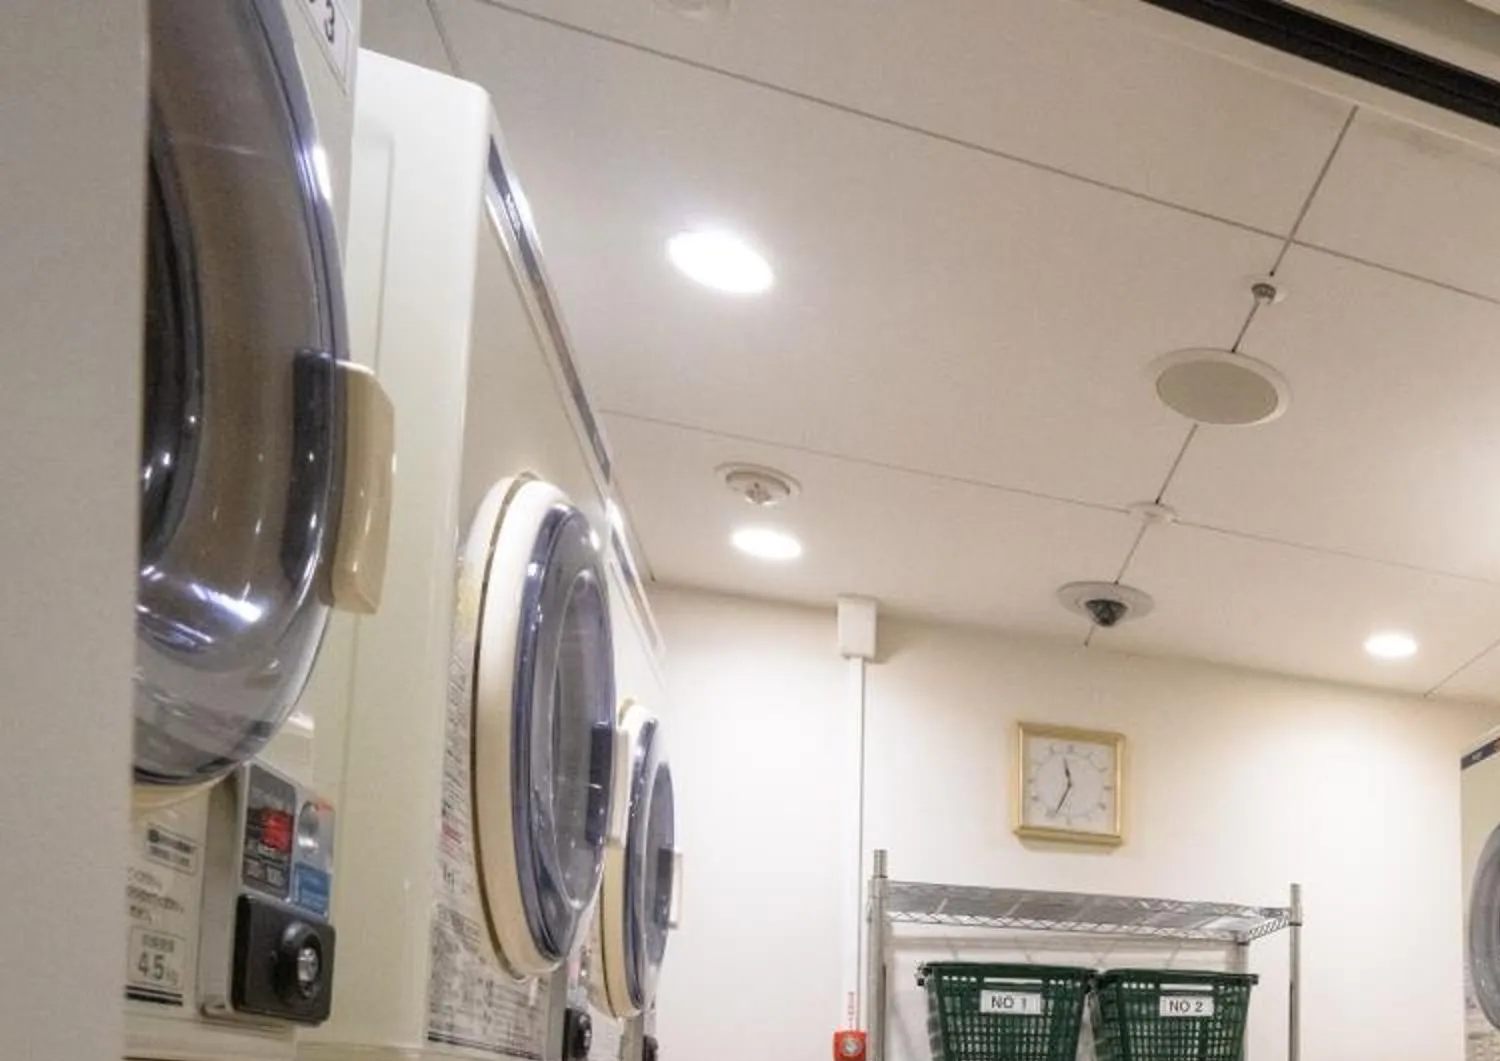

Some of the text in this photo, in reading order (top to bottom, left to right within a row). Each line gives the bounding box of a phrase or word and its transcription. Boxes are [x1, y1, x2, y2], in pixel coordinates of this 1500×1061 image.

[991, 996, 1028, 1009] NO 1
[1169, 1000, 1204, 1013] NO 2
